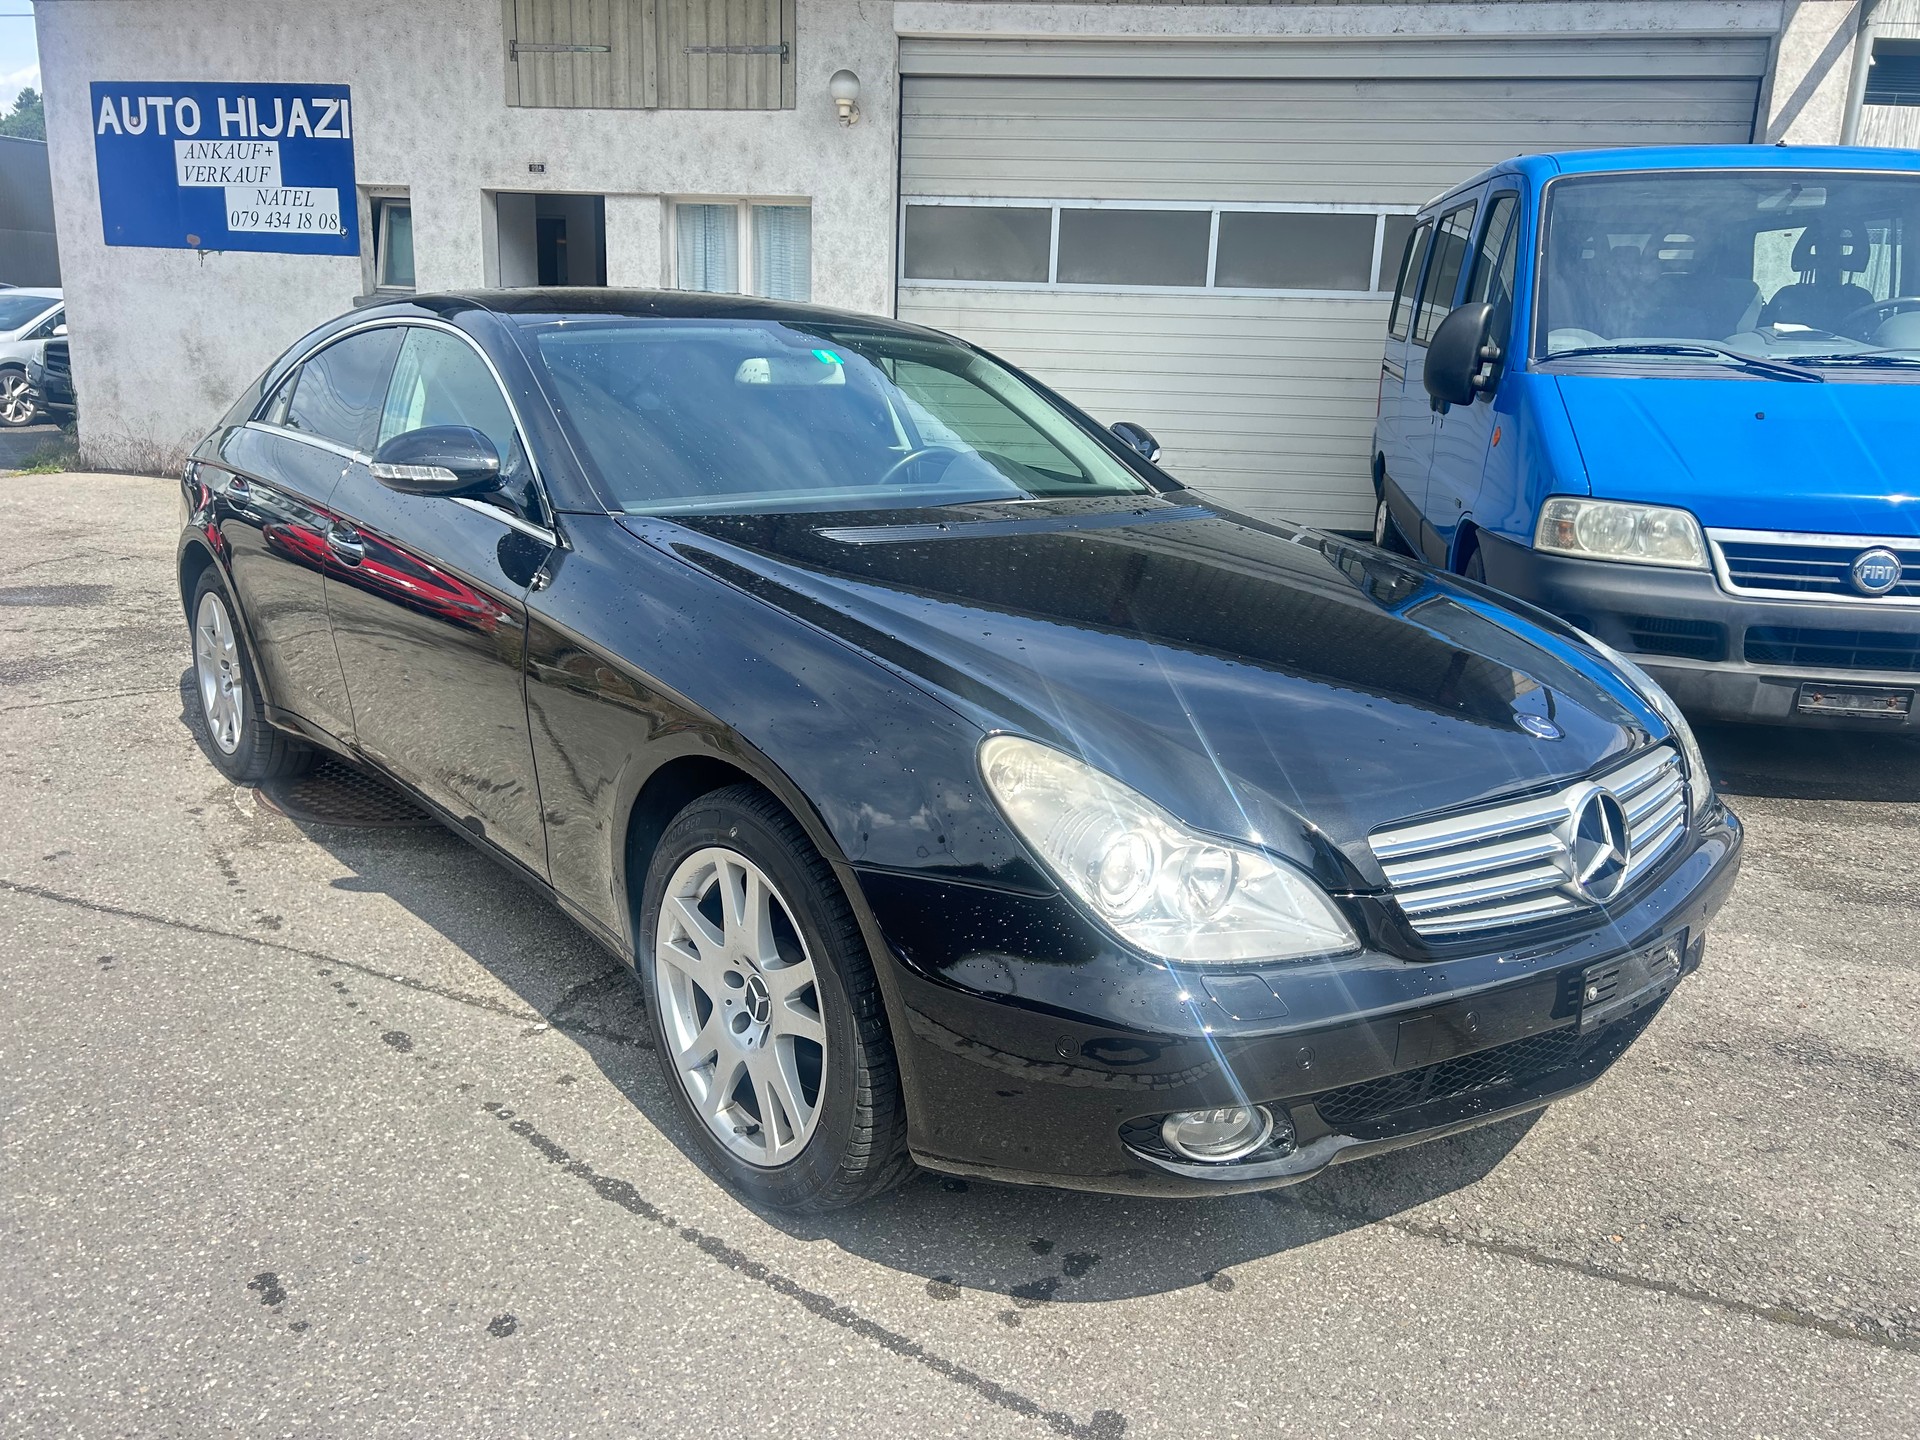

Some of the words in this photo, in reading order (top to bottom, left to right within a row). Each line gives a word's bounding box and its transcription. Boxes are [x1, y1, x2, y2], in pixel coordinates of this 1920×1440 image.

[97, 96, 201, 136] AUTO
[217, 97, 350, 139] HIJAZI
[183, 142, 274, 160] ANKAUF+
[184, 165, 271, 183] VERKAUF
[255, 189, 315, 208] NATEL
[231, 211, 259, 227] 079
[264, 212, 291, 228] 434
[296, 212, 313, 229] 18
[318, 213, 338, 230] 08
[1862, 565, 1893, 580] FIAT
